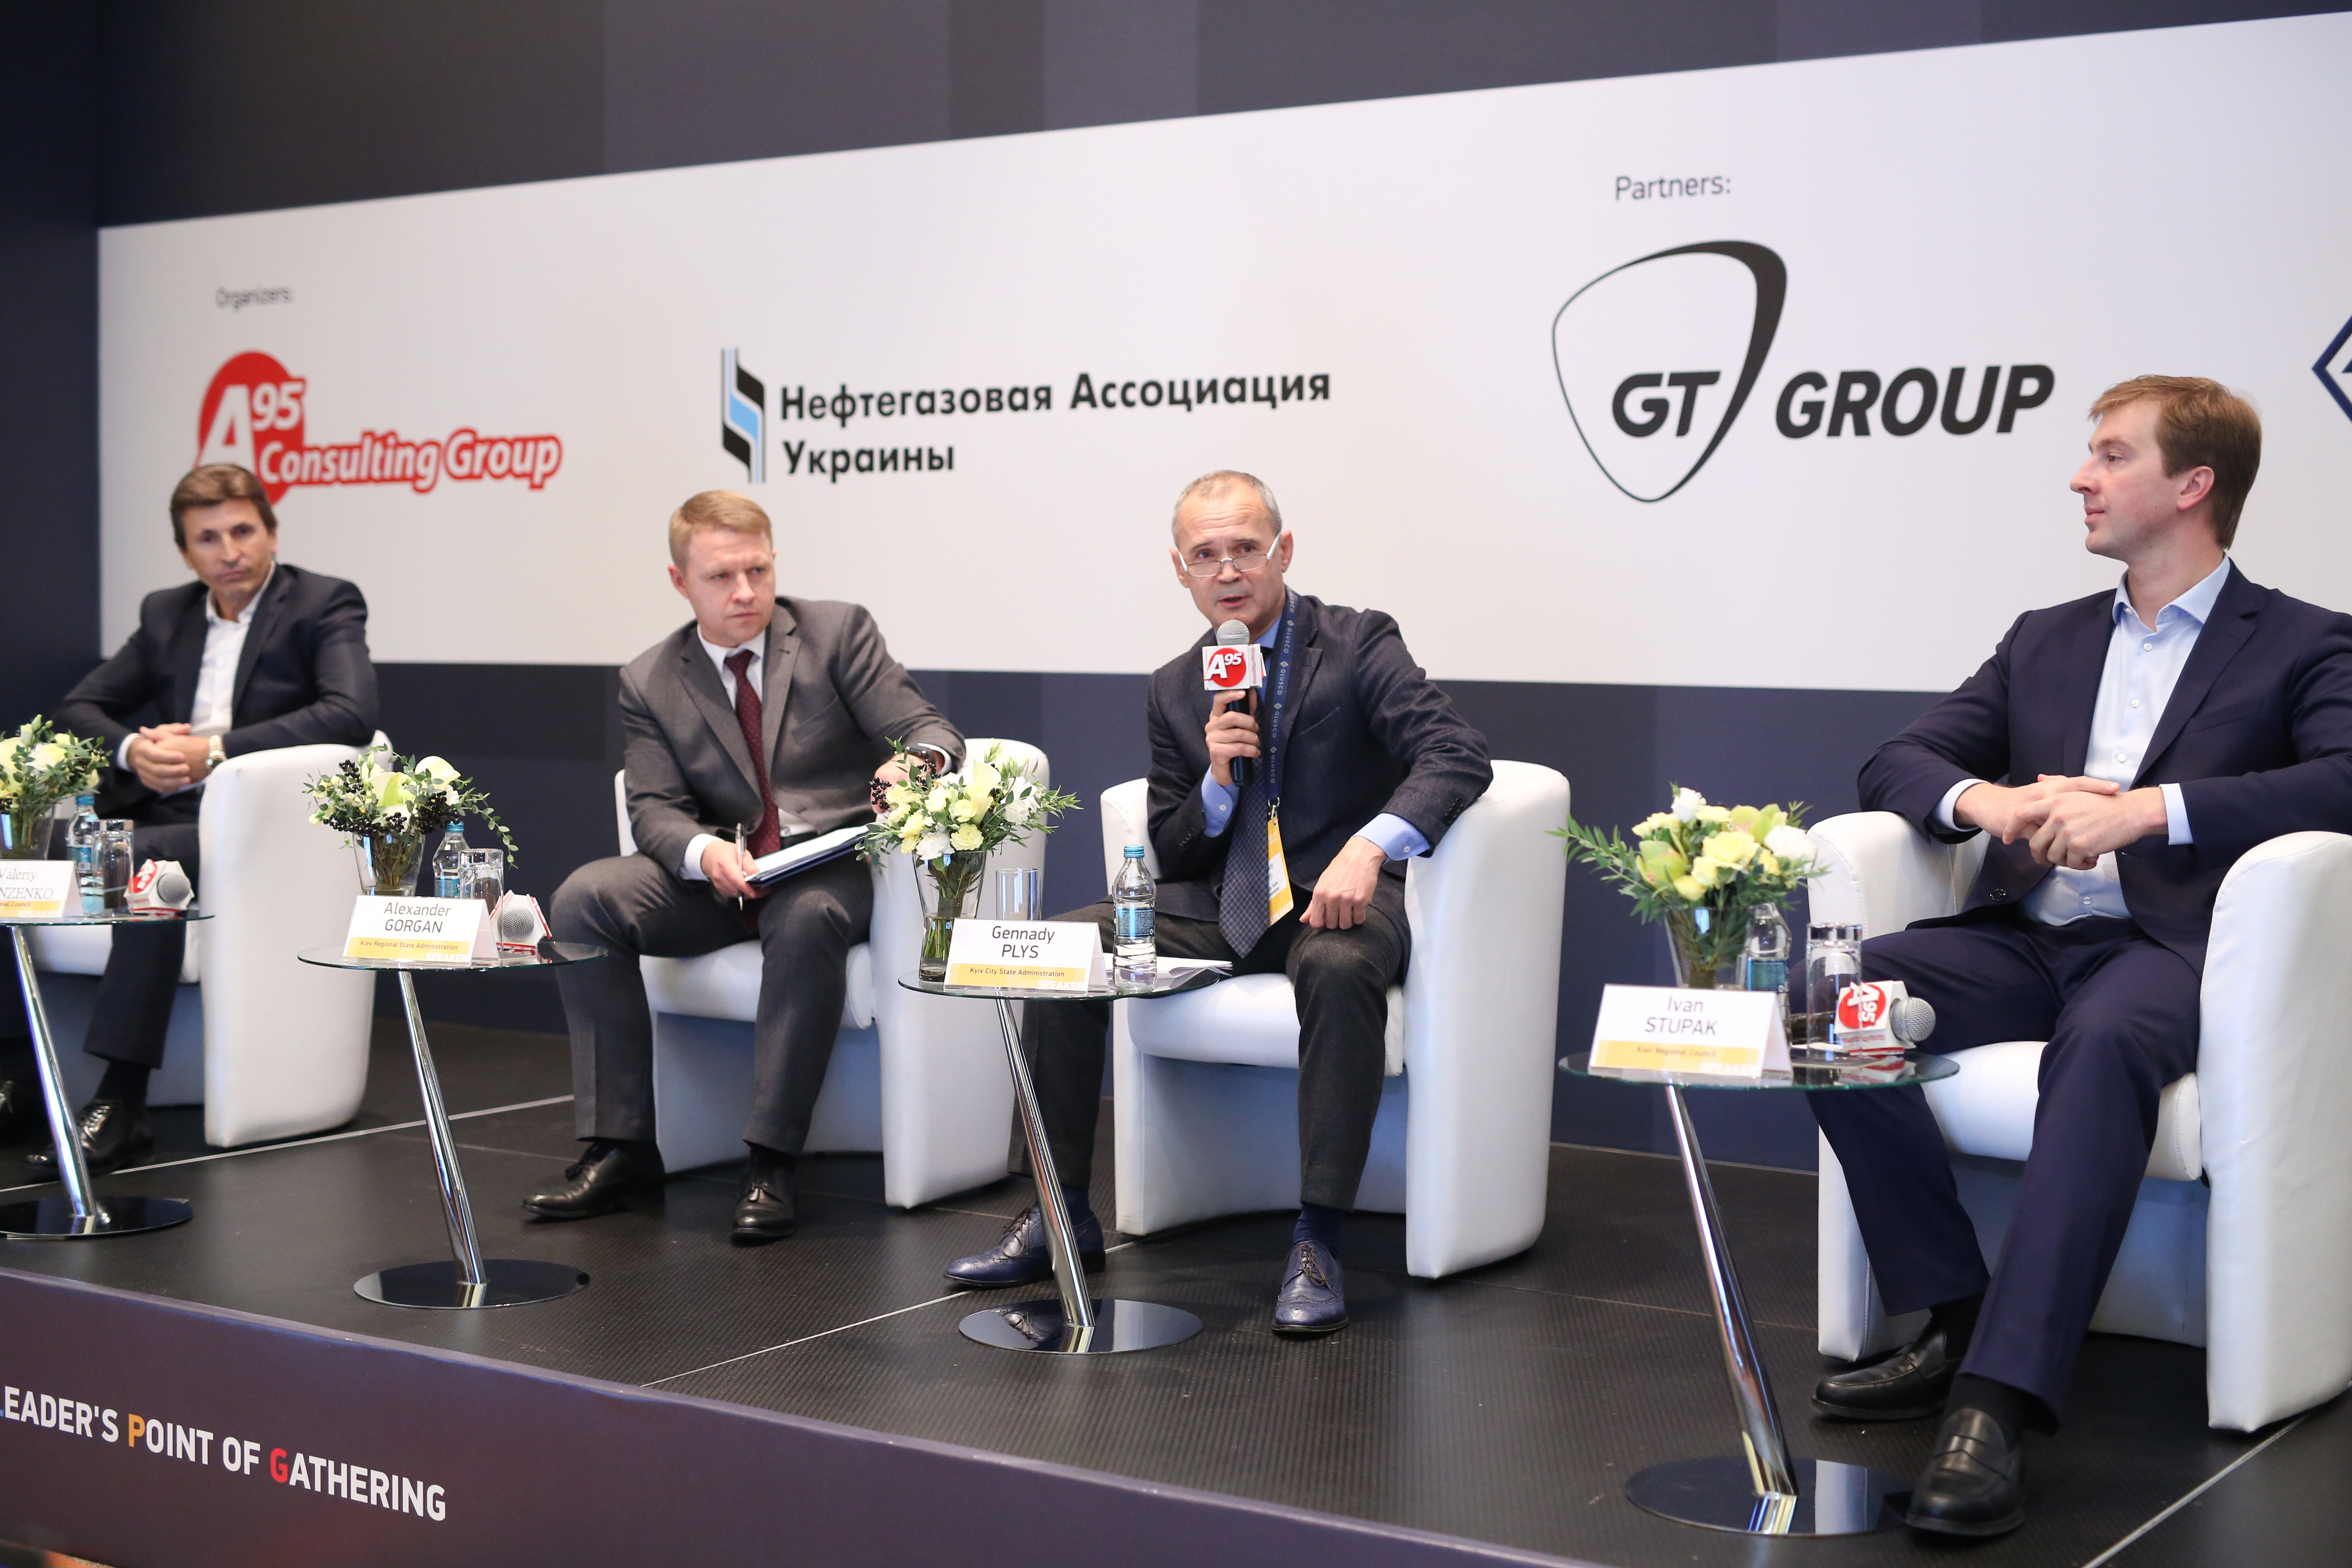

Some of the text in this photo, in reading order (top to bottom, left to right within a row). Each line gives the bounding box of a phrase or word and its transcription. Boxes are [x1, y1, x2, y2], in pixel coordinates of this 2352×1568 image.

[1615, 174, 1732, 200] Partners:
[781, 372, 1330, 429] Нефтегазовая Ассоциация
[1612, 370, 1721, 438] GT
[1775, 364, 2056, 439] GROUP
[259, 430, 562, 491] Consulting Group
[782, 440, 955, 483] Украины
[383, 902, 452, 916] Alexander
[385, 919, 443, 933] GORGAN
[992, 925, 1055, 944] Gennady
[425, 952, 469, 962] SPEAKER
[1002, 944, 1039, 958] PLYS
[1036, 980, 1085, 991] SPEAKER
[1668, 996, 1704, 1013] Ivan
[1645, 1016, 1718, 1036] STUPAK
[0, 1385, 446, 1521] EADER'S POINT OF GATHERING
